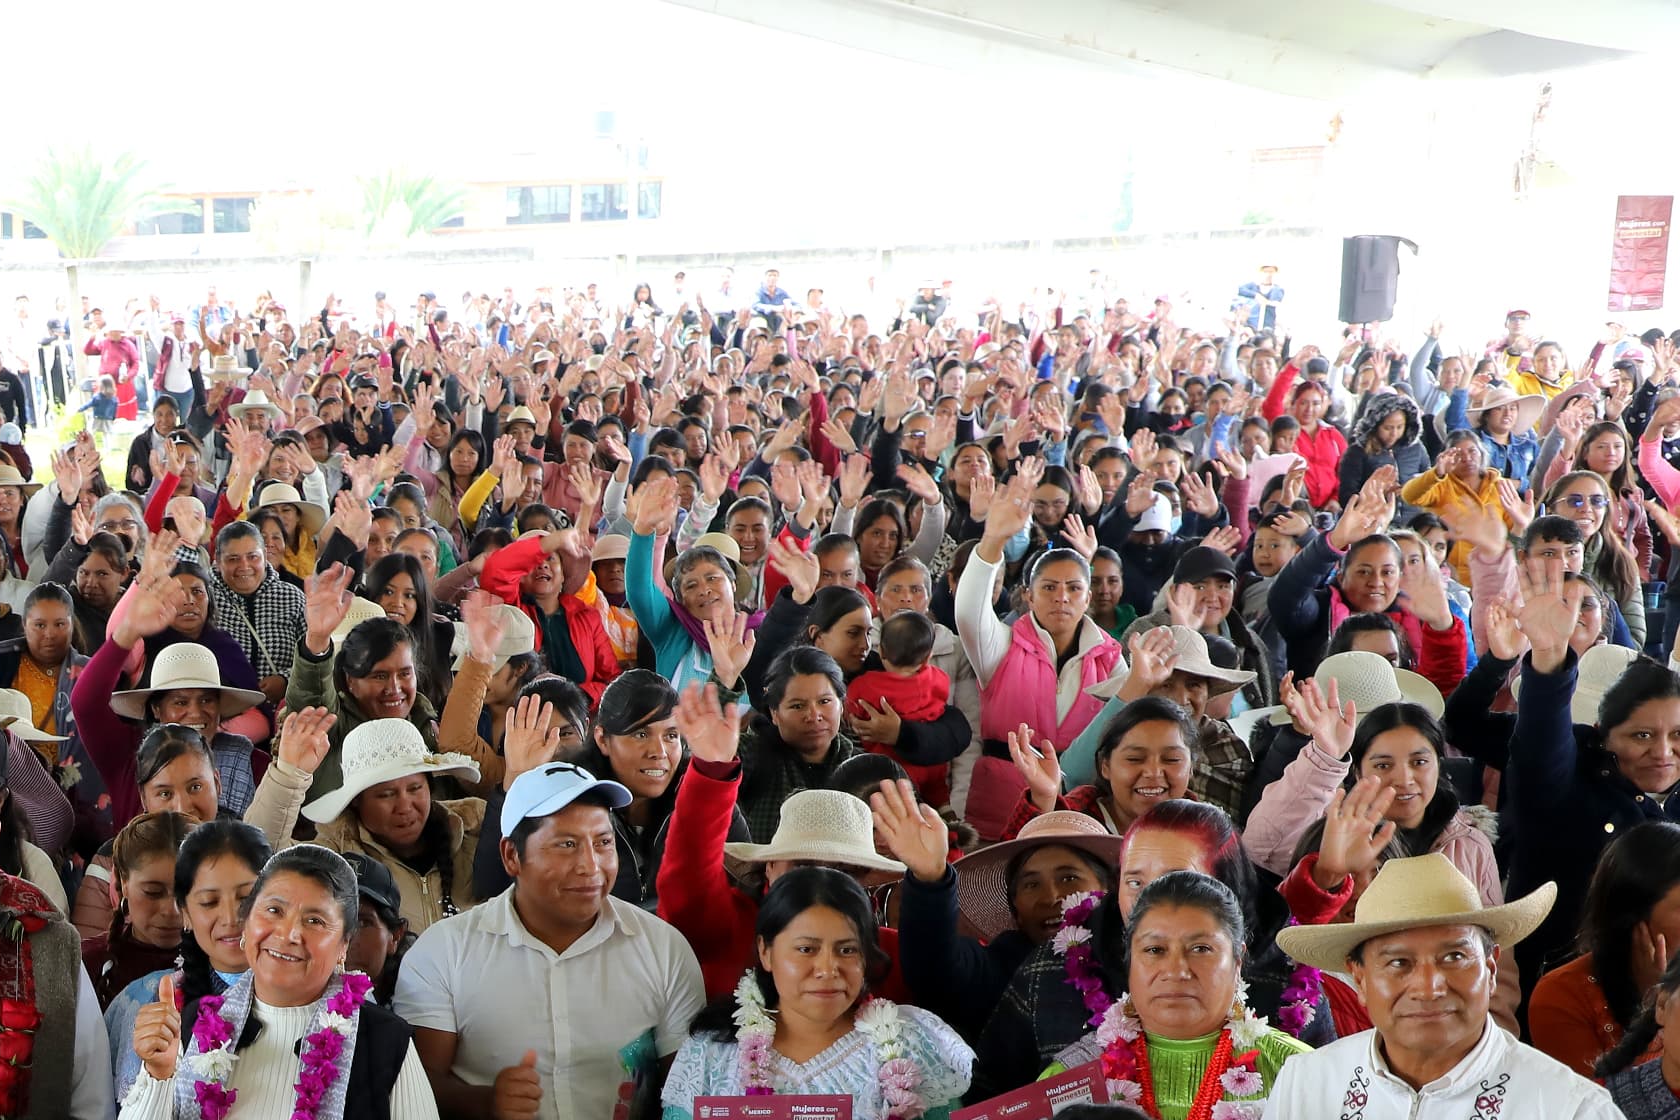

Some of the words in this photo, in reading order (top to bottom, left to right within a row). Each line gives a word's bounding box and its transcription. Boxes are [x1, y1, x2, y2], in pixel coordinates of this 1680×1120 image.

[1046, 1081, 1078, 1097] Mujeres
[1079, 1077, 1091, 1085] con
[1051, 1087, 1089, 1105] Bienestar
[791, 1105, 825, 1114] Mujeres
